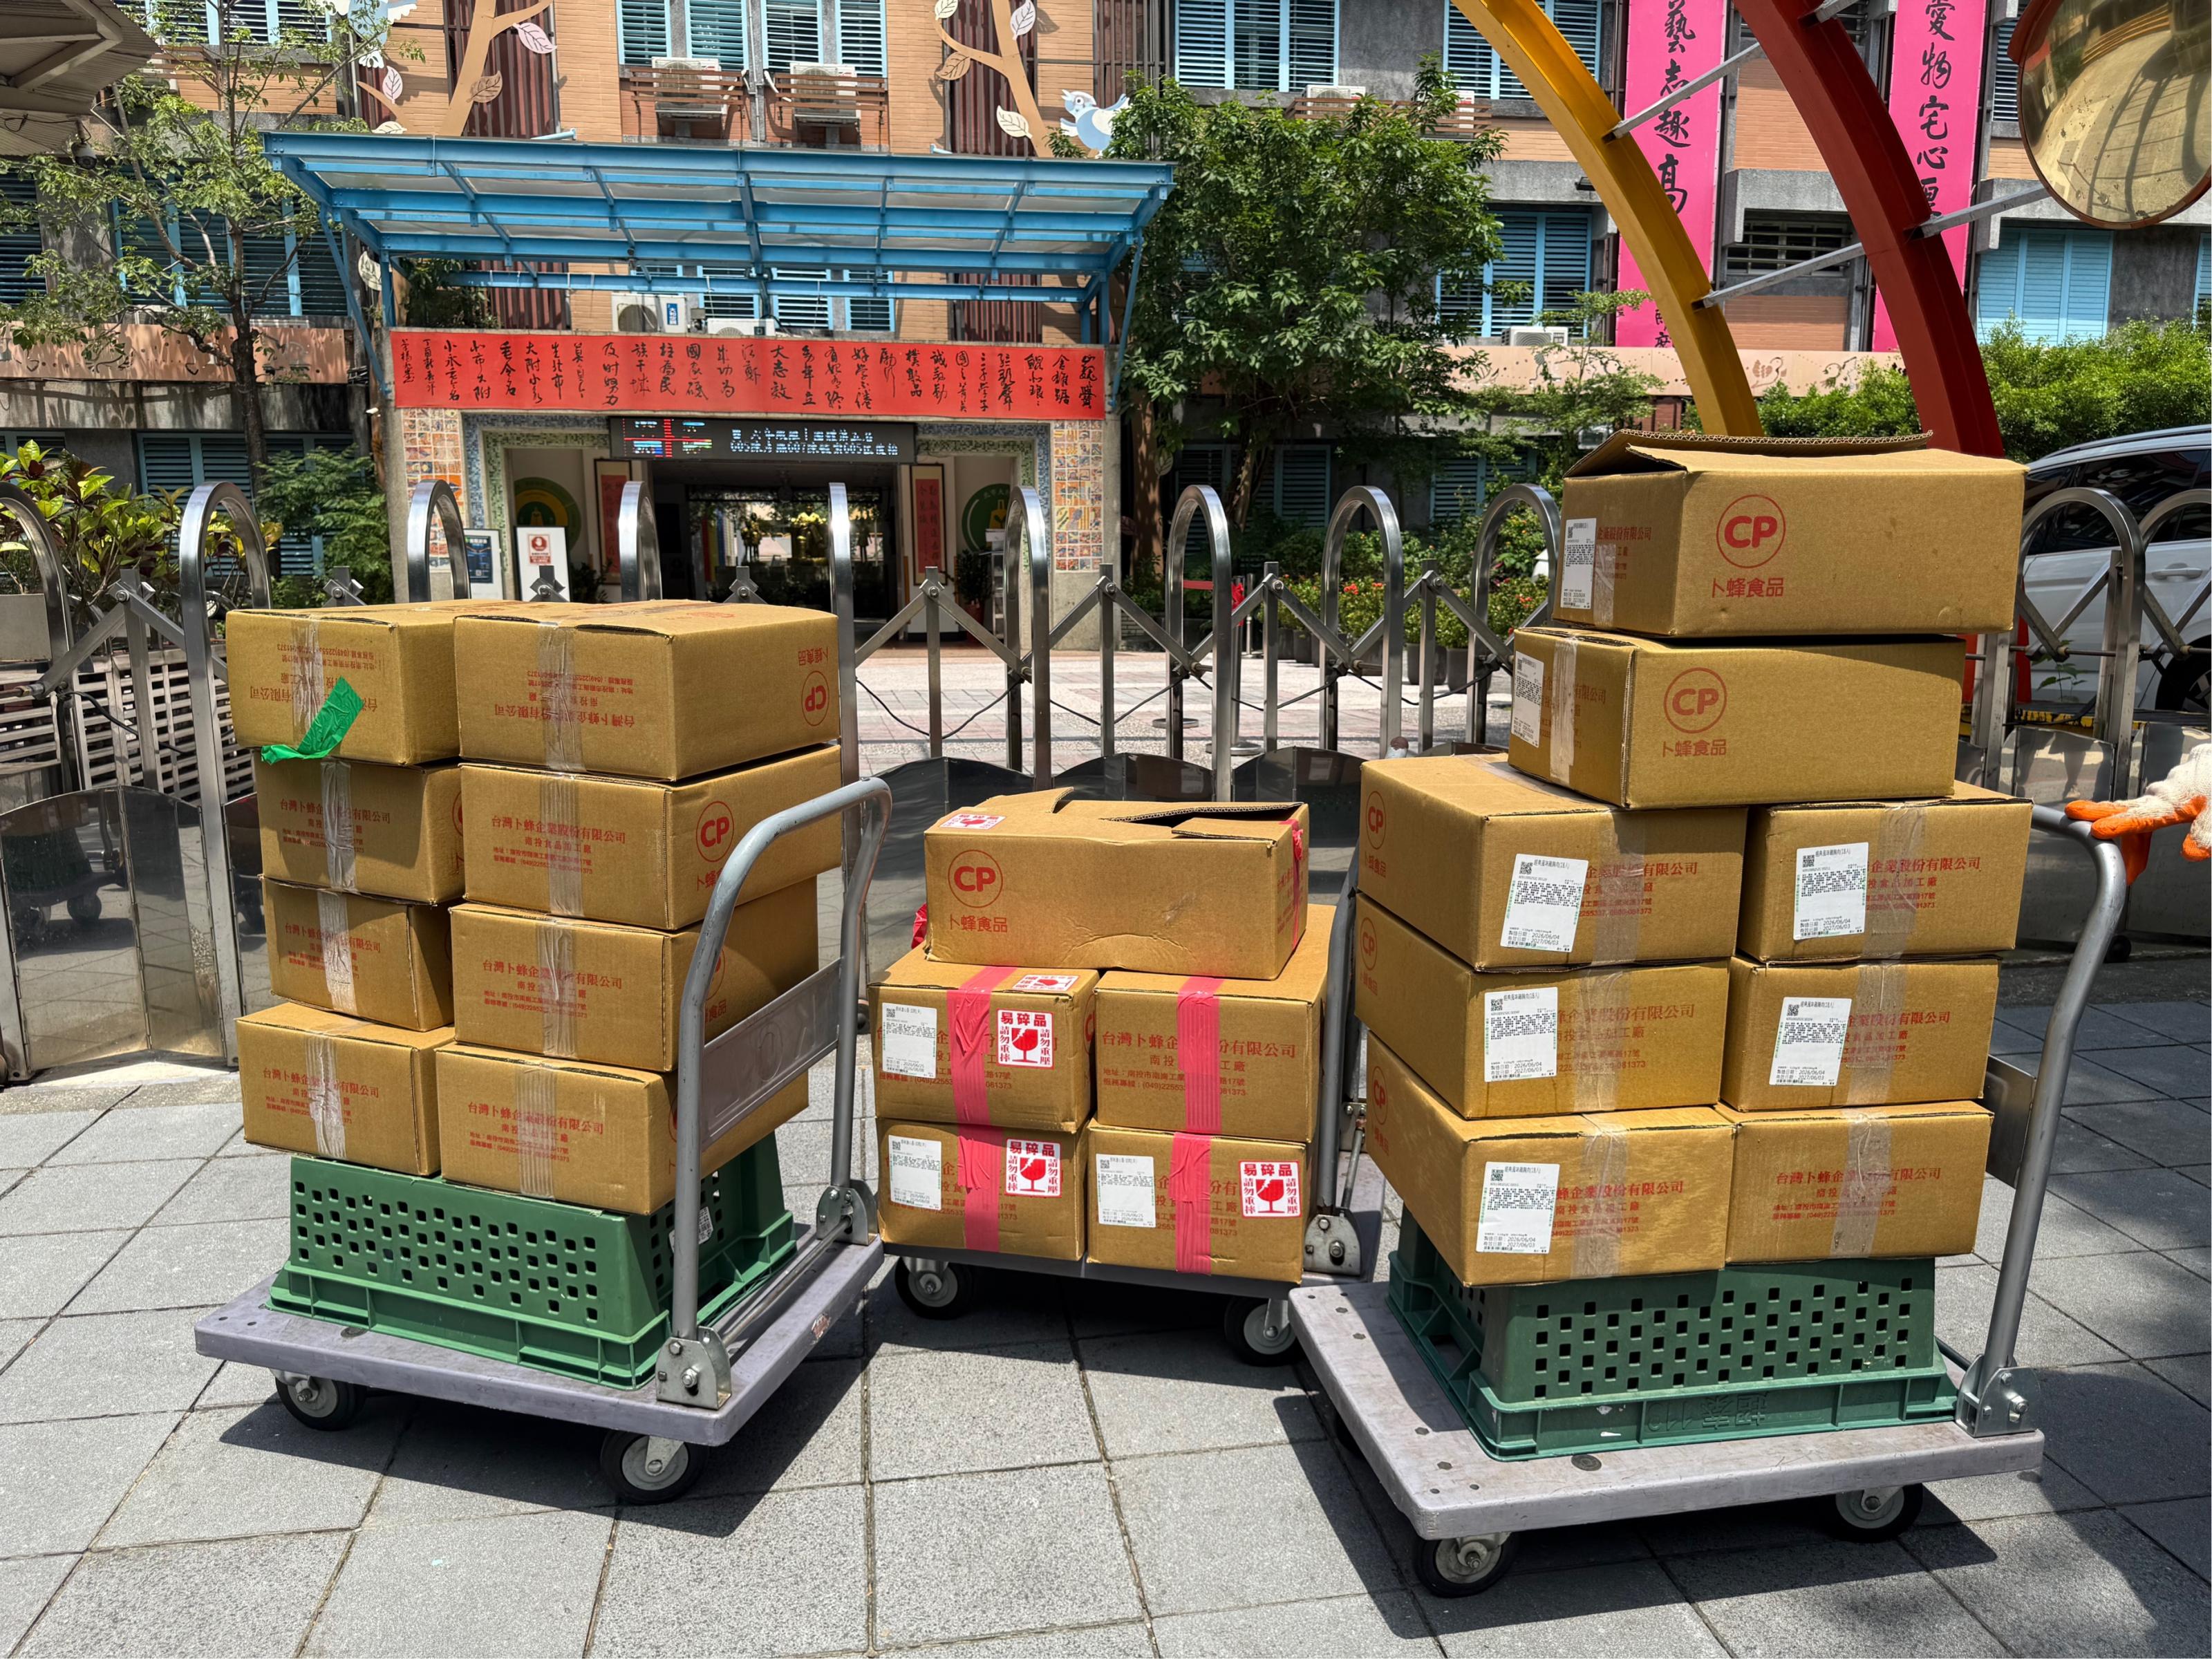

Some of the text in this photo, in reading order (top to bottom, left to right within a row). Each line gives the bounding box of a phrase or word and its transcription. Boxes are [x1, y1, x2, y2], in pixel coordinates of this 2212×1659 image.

[1724, 516, 1778, 548] CP
[1712, 577, 1785, 598] 卜蜂食品
[805, 684, 827, 712] CP
[1672, 688, 1719, 715] CP
[1662, 739, 1727, 758] 卜蜂食品
[700, 816, 730, 848] CP
[1369, 806, 1384, 834] CP
[954, 866, 996, 892] CP
[950, 914, 1008, 932] 卜蜂食品
[1000, 1011, 1047, 1028] 易碎品
[1103, 1031, 1296, 1058] 台灣卜蜂企份有限公司
[1010, 1141, 1055, 1156] 易碎品
[1244, 1163, 1293, 1177] 易碎品
